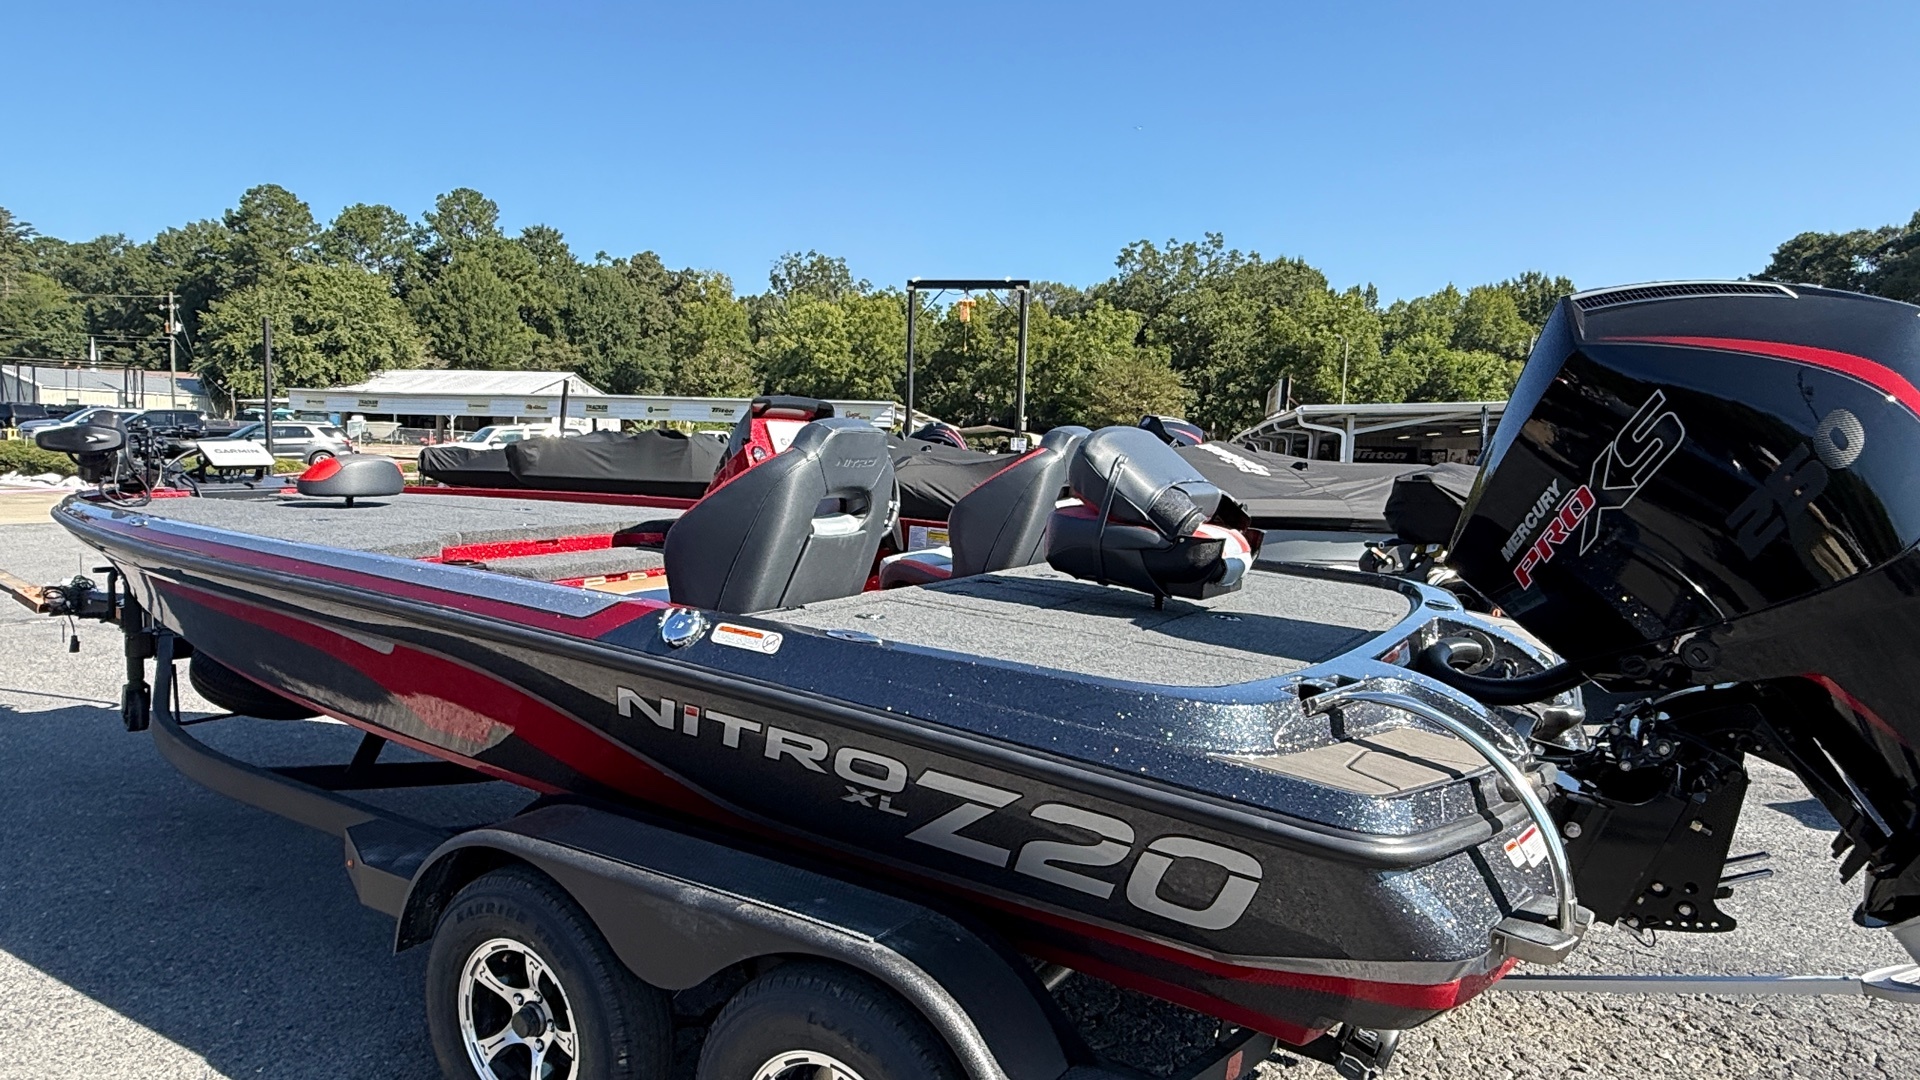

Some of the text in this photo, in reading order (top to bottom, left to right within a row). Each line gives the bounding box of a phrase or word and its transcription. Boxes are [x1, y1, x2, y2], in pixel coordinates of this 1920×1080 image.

[711, 406, 735, 414] Triton
[836, 456, 878, 468] NITRO
[1354, 448, 1408, 460] Triton
[1513, 389, 1685, 590] PRO XS
[1725, 408, 1865, 561] 250
[1500, 478, 1562, 562] MERCURY
[842, 785, 908, 817] XL
[905, 768, 1263, 930] Z20
